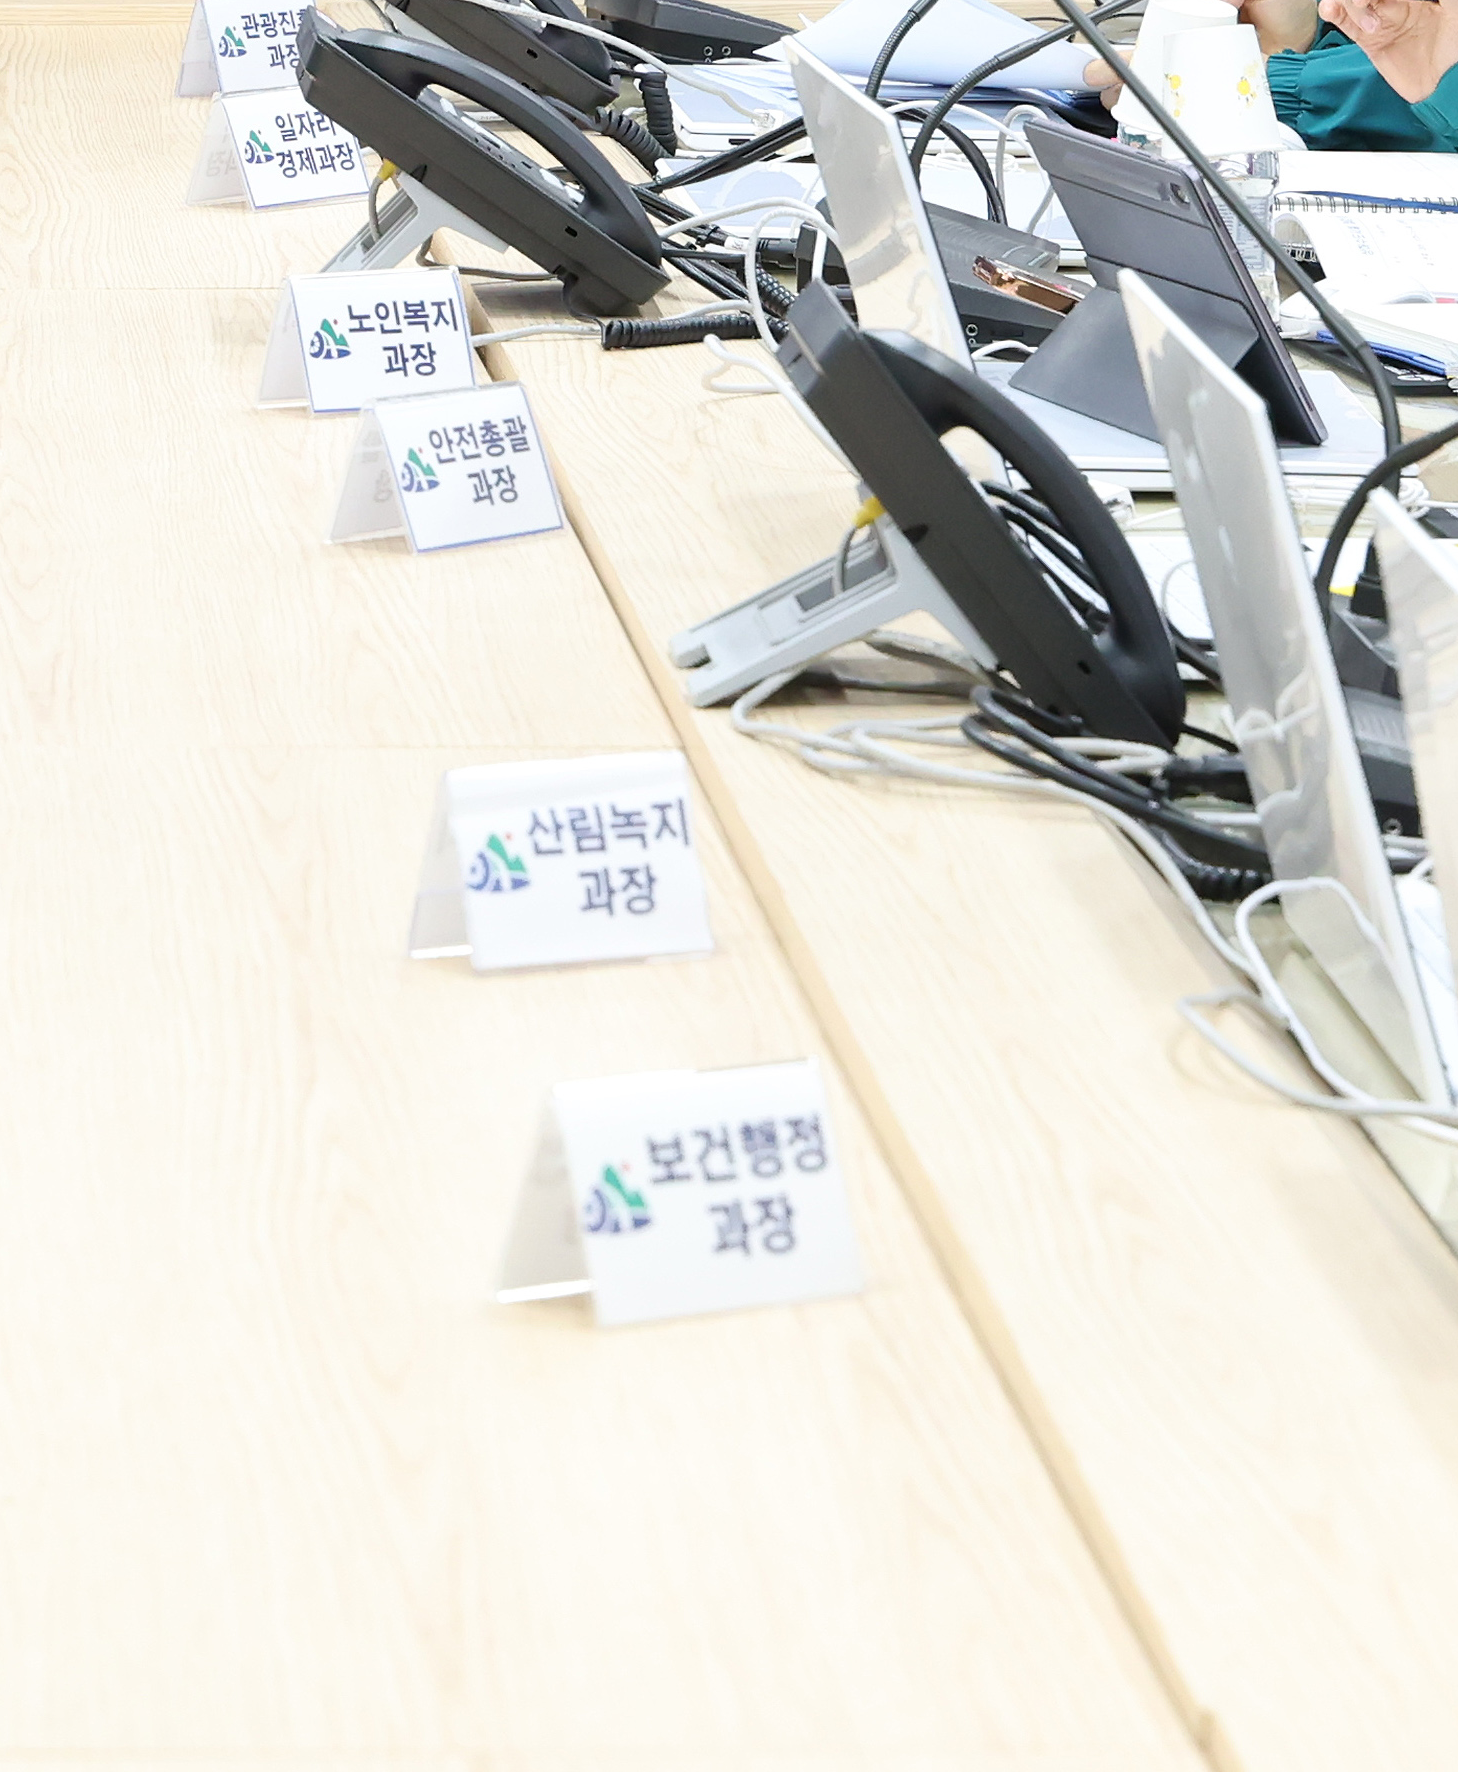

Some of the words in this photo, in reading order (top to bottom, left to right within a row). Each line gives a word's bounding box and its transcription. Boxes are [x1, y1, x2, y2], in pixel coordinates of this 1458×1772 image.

[275, 111, 337, 142] 일자리
[276, 141, 355, 179] 경제과장
[347, 298, 459, 336] 노인복지
[382, 341, 438, 378] 과장
[428, 415, 531, 465] 안전총괄
[467, 465, 519, 506] 과장
[527, 799, 691, 857] 산림녹지
[578, 863, 658, 917] 과장
[646, 1111, 829, 1186] 보건행정
[708, 1195, 798, 1259] 과장
